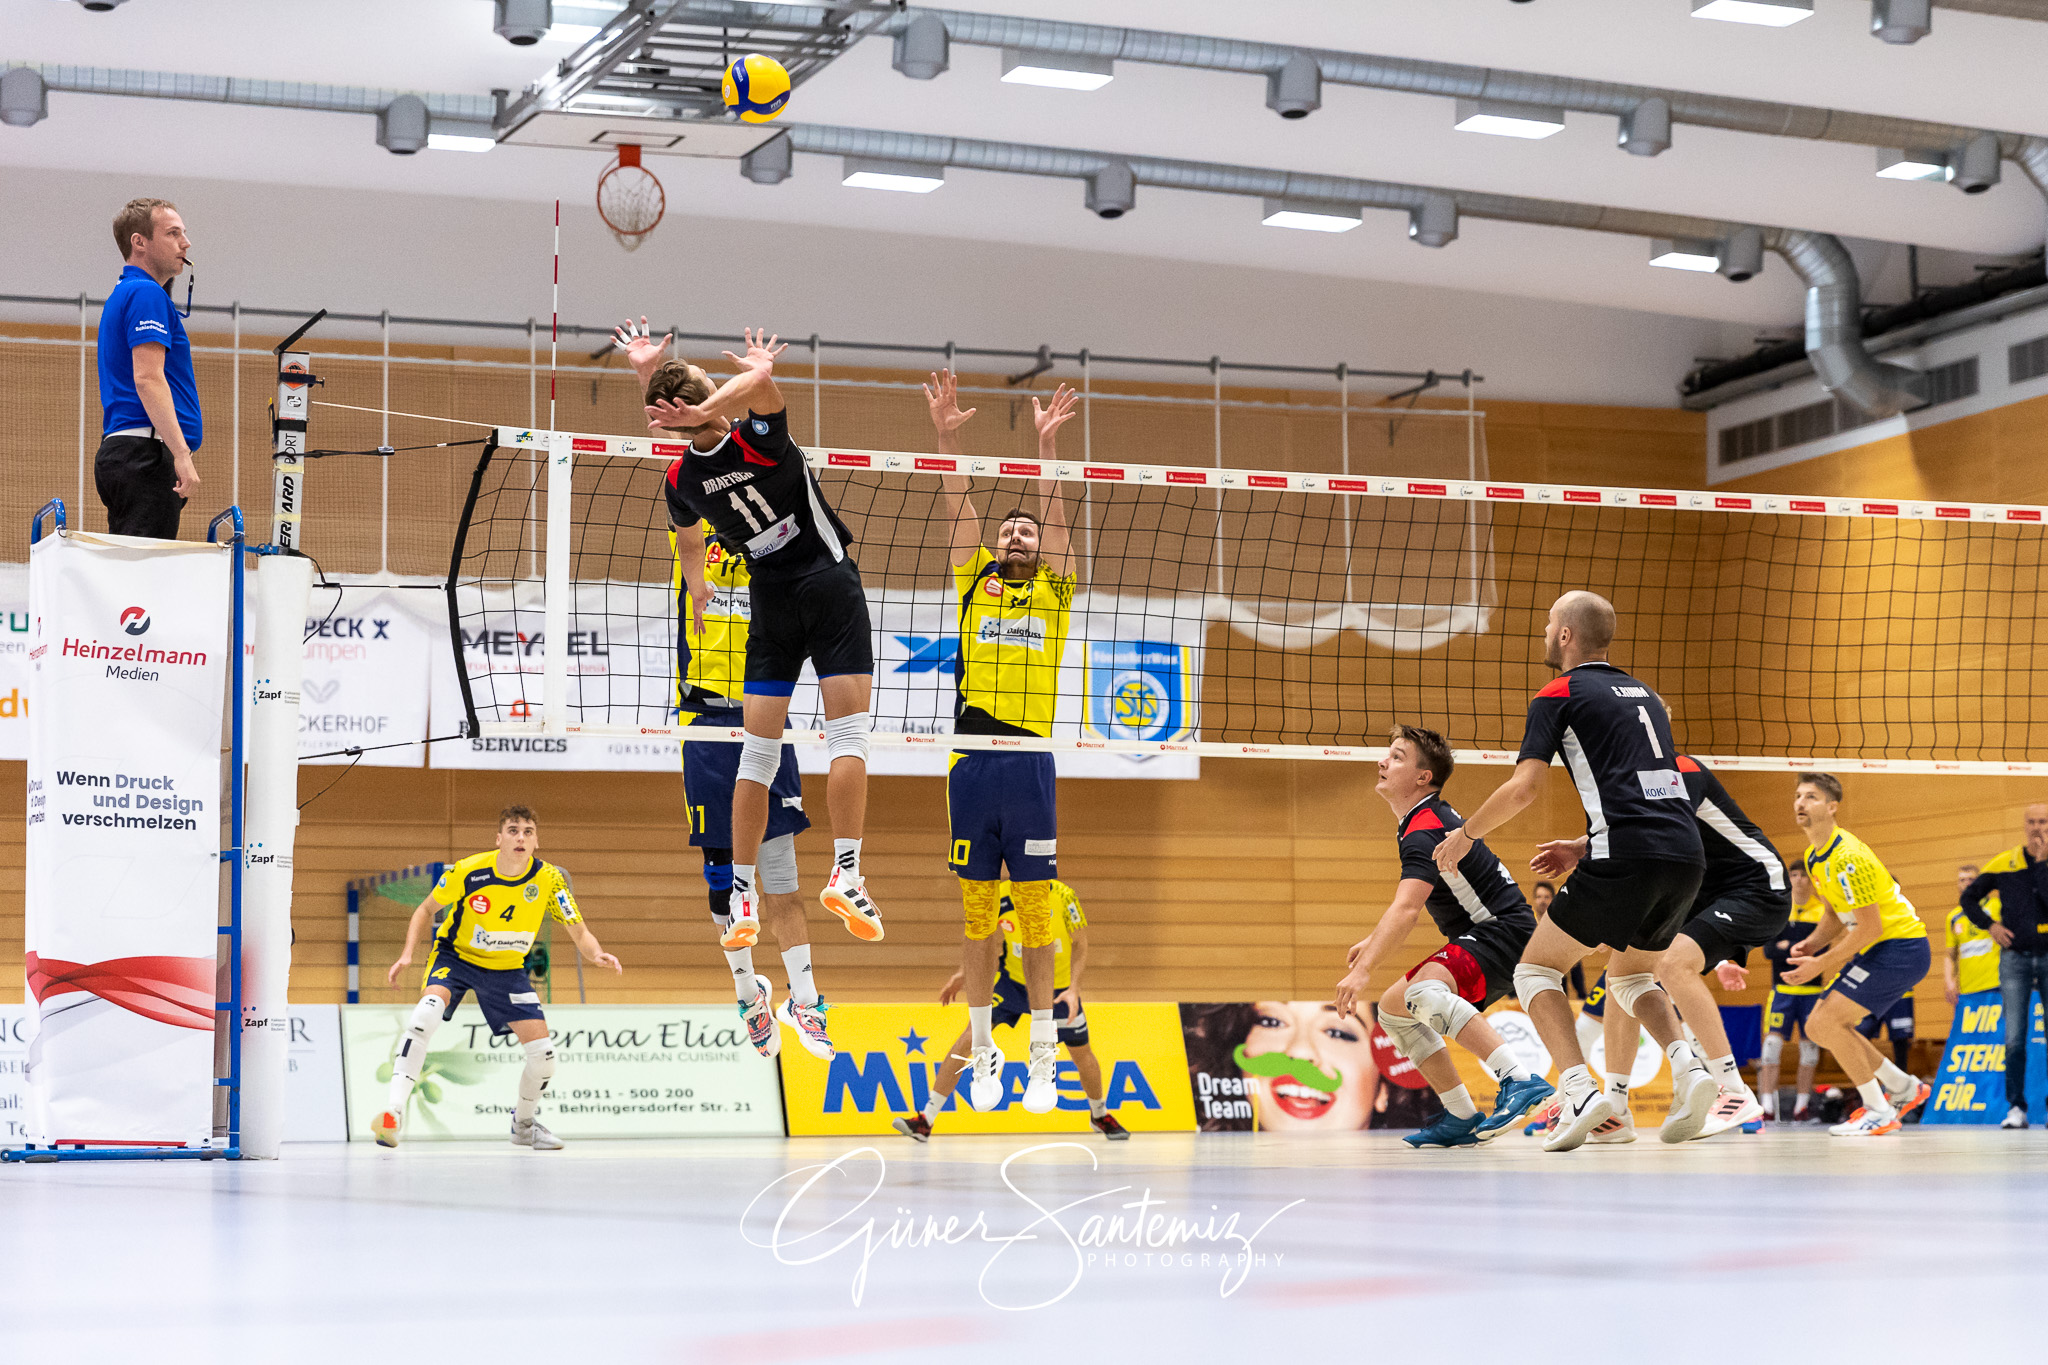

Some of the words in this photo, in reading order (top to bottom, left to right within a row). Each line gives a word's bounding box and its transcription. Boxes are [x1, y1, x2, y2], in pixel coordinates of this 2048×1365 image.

[284, 433, 297, 465] PORT
[279, 476, 295, 549] ERARD
[728, 484, 778, 534] 11
[303, 617, 364, 638] PECK
[62, 637, 207, 666] Heinzelmann
[459, 629, 610, 656] MEYEL
[302, 642, 367, 663] umpen
[105, 665, 159, 682] Medien
[258, 690, 282, 700] Zapf
[298, 714, 388, 733] CKERHOF
[1638, 706, 1664, 759] 1
[472, 738, 568, 753] SERVICES
[56, 771, 111, 788] Wenn
[115, 774, 175, 790] Druck
[1644, 787, 1666, 797] KOKI
[93, 793, 130, 808] und
[136, 794, 203, 815] Design
[62, 813, 197, 831] verschmelzen
[251, 854, 275, 865] Zapf
[499, 904, 516, 922] 4
[431, 966, 451, 980] 4
[244, 1018, 269, 1029] Zapf
[1961, 1004, 2003, 1033] WIR
[462, 1022, 650, 1049] Taerna
[657, 1020, 749, 1049] Elia
[559, 1052, 672, 1063] DITERRANEAN
[678, 1052, 740, 1063] CUISINE
[542, 1089, 567, 1099] el.:
[572, 1089, 611, 1099] 0911
[630, 1089, 660, 1099] 500
[665, 1088, 694, 1098] 200
[1197, 1072, 1260, 1096] Dream
[475, 1103, 541, 1116] Schwg
[559, 1102, 694, 1116] Behringersdorfer
[700, 1102, 726, 1112] Str.
[734, 1102, 752, 1112] 21
[1200, 1096, 1252, 1119] Team
